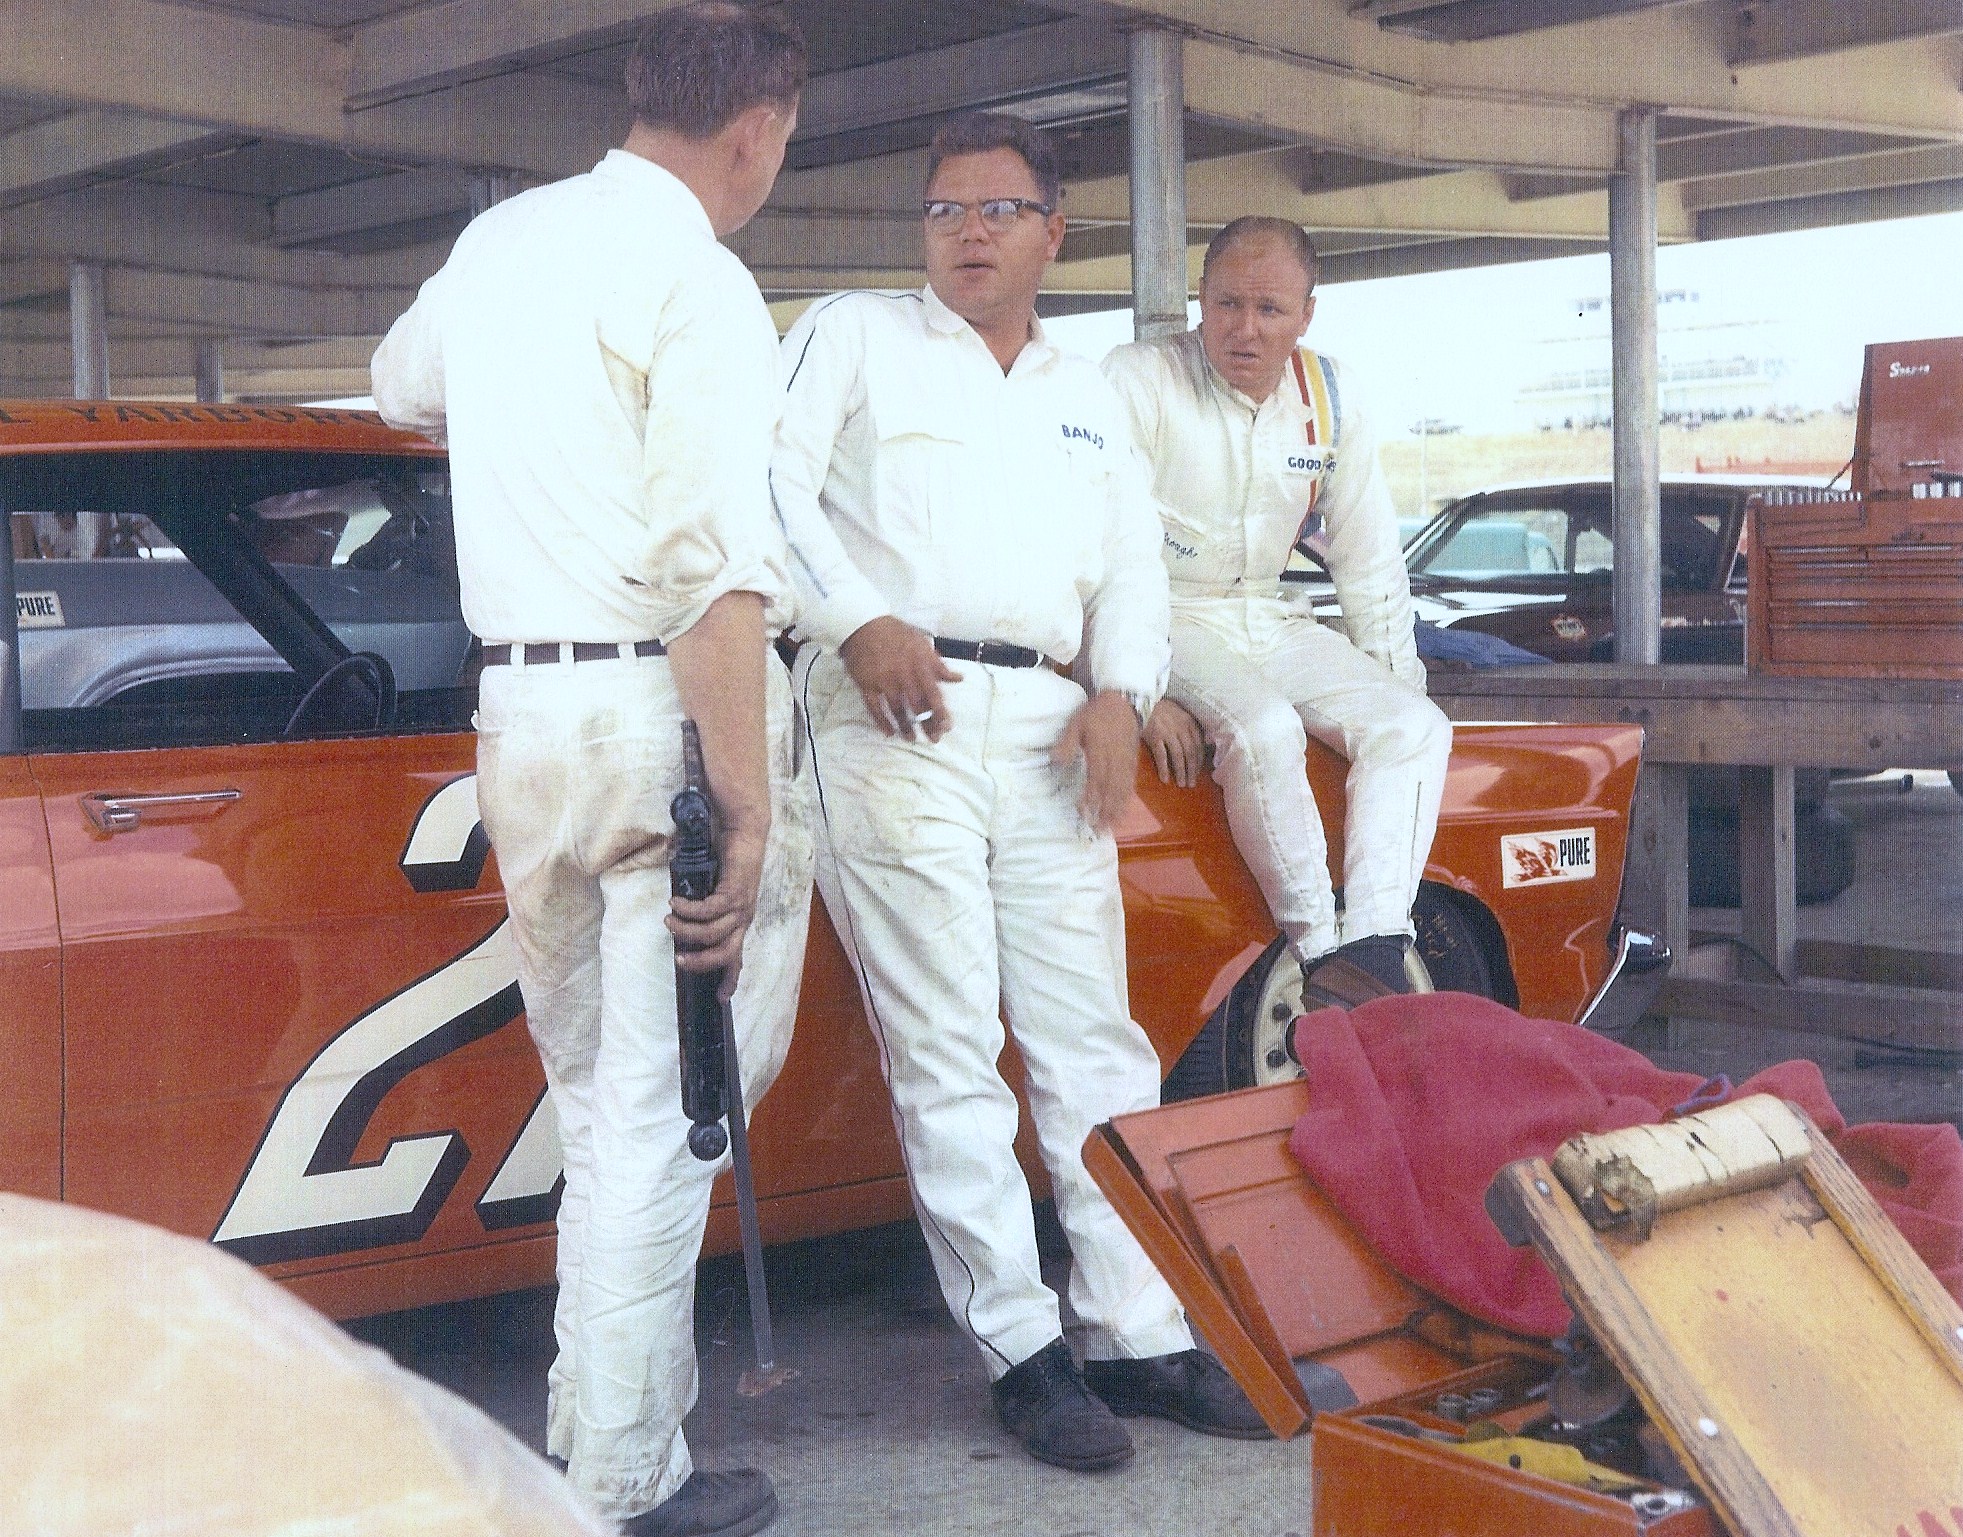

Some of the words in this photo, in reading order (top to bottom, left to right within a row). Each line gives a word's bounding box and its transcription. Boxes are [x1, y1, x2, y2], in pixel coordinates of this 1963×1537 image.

[1061, 424, 1104, 450] BANJO
[1287, 456, 1337, 473] GOOD
[17, 596, 55, 616] PURE
[1559, 836, 1591, 867] PURE
